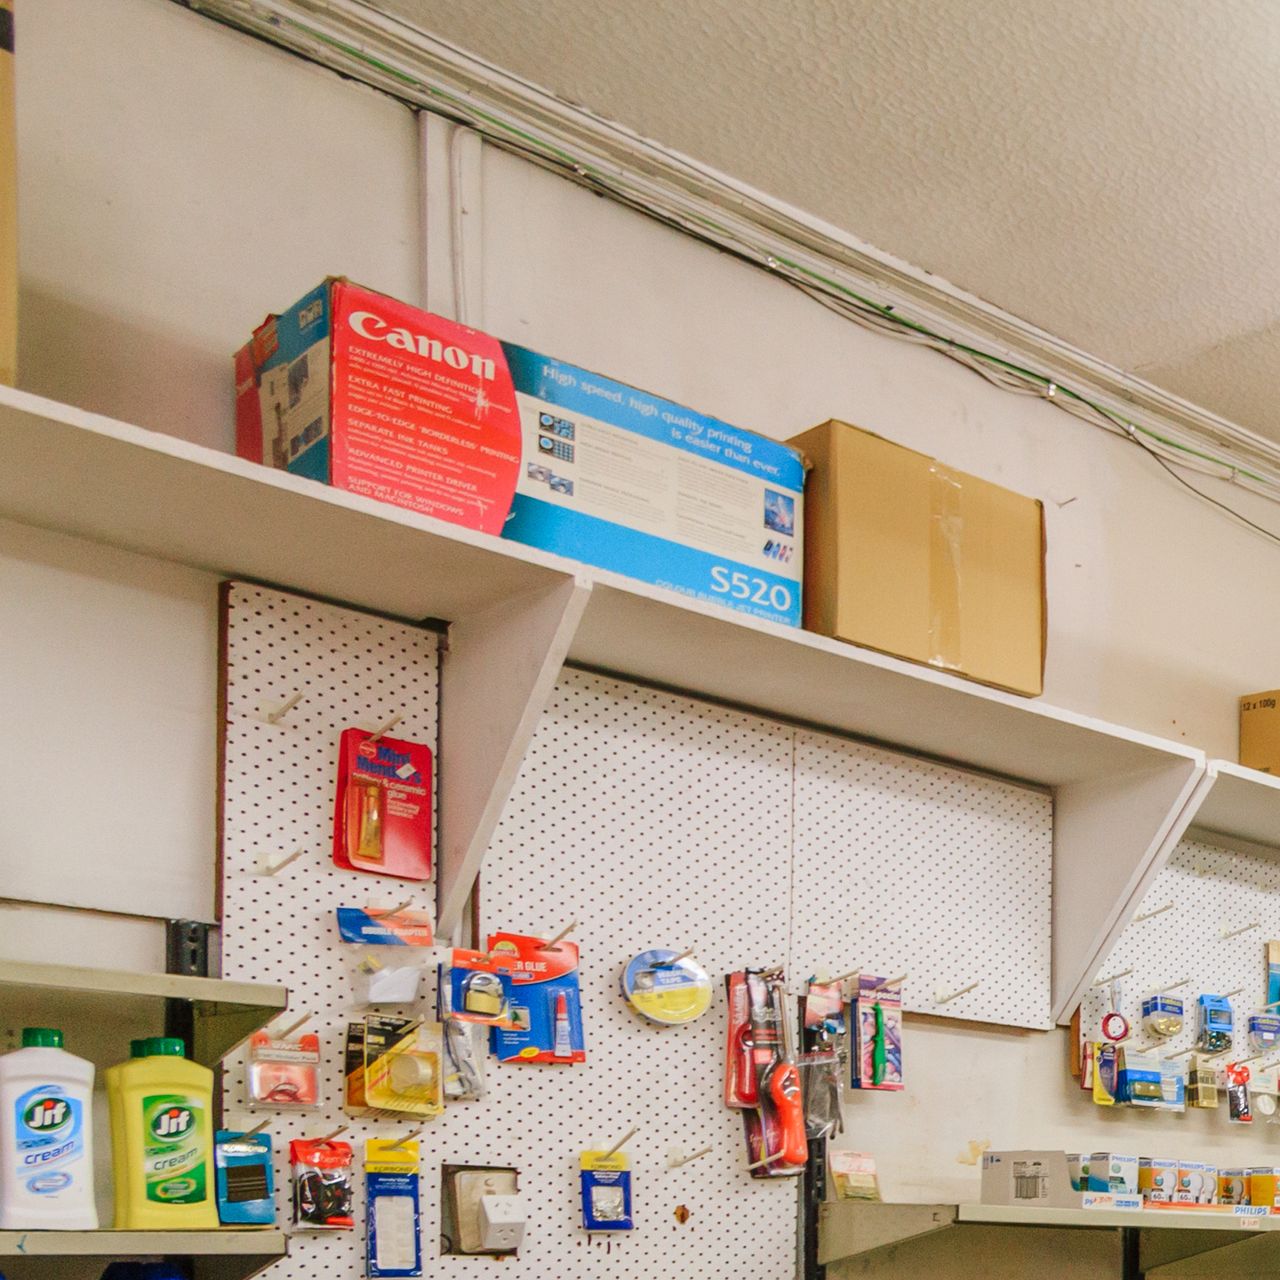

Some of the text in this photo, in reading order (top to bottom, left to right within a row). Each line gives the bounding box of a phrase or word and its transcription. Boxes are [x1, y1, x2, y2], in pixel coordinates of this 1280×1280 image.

[348, 310, 496, 381] Canon
[348, 374, 453, 414] EXTRA FAST PRINTING
[542, 364, 576, 388] High
[630, 391, 658, 417] high
[662, 407, 706, 434] quality
[708, 424, 752, 454] printing
[672, 428, 781, 476] is easier than ever.
[348, 447, 478, 492] ADVANCED PRINTER DRIVER
[710, 565, 791, 612] S520
[1242, 702, 1251, 711] 12
[1259, 698, 1276, 709] 100g
[28, 1100, 67, 1128] Jif
[158, 1110, 191, 1134] Jif
[24, 1140, 75, 1166] cream
[152, 1148, 198, 1172] cream
[1235, 1206, 1267, 1215] PHILIPS
